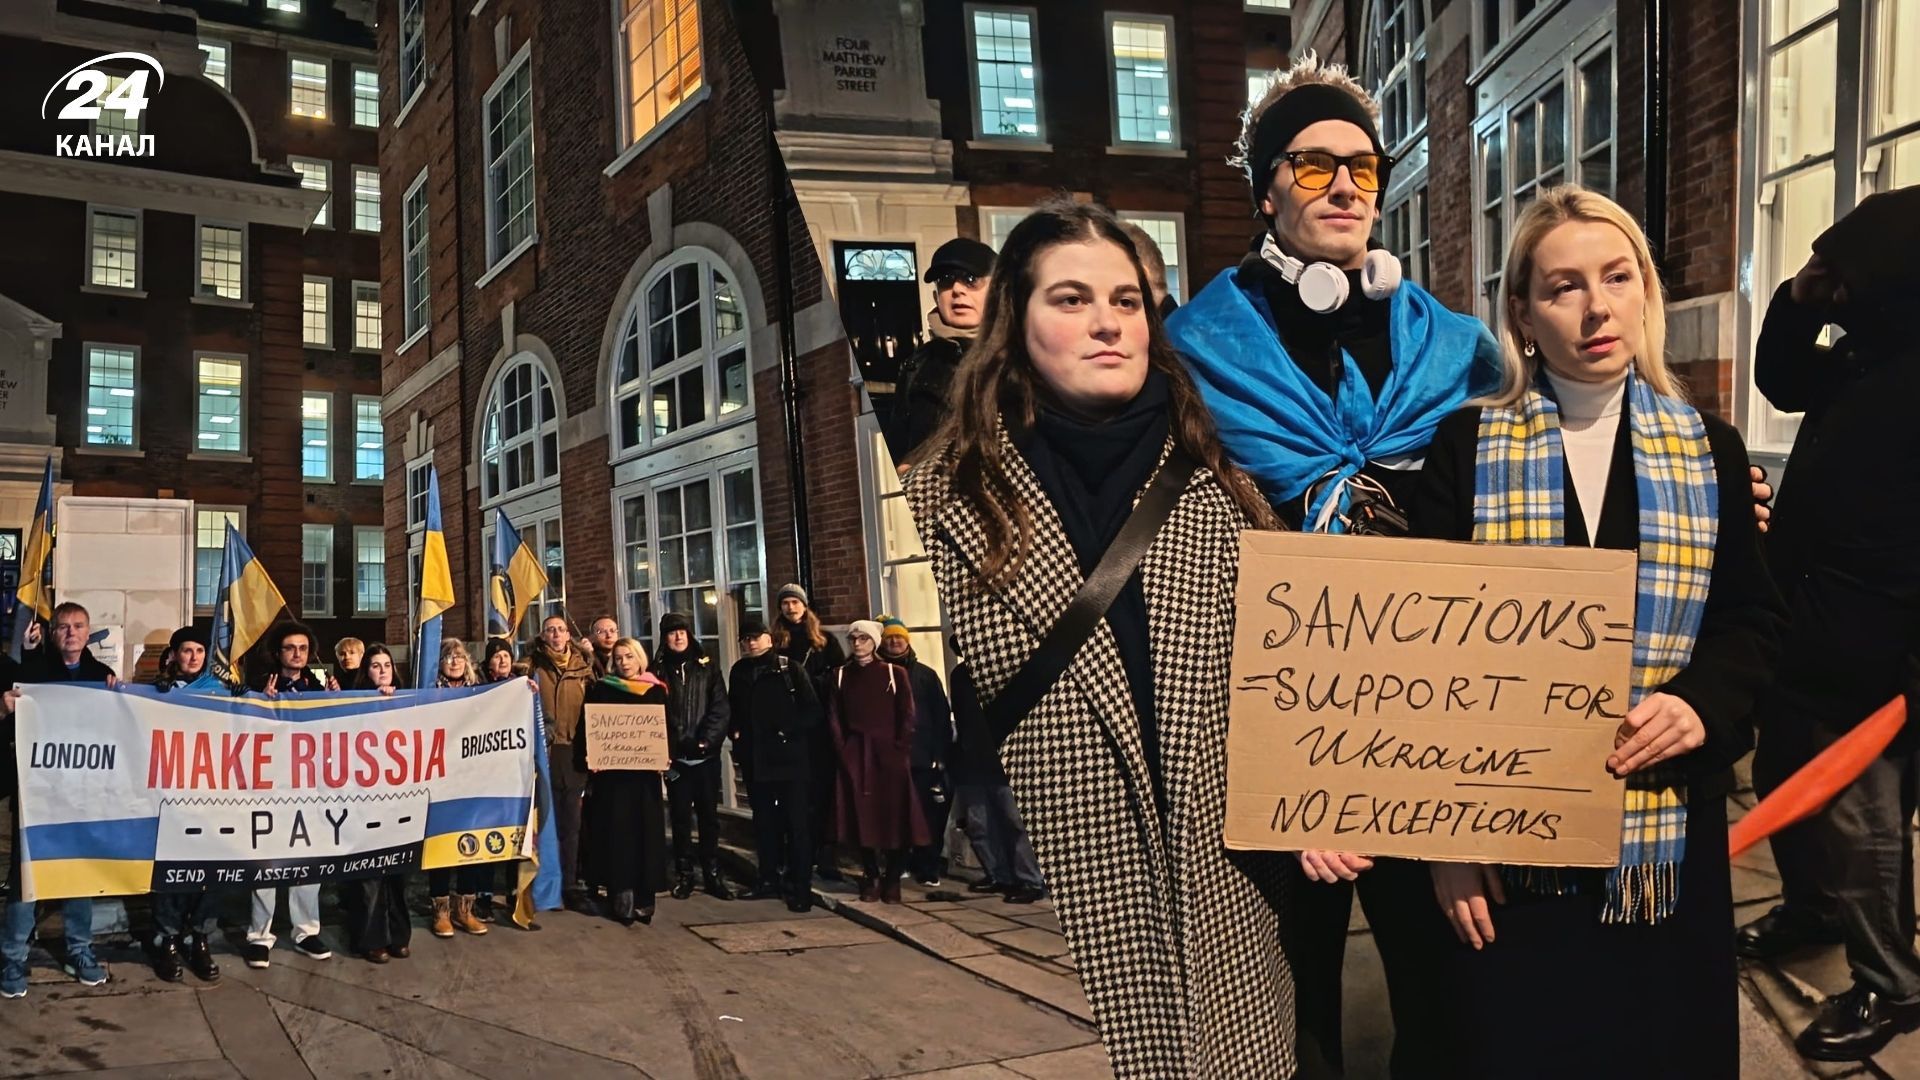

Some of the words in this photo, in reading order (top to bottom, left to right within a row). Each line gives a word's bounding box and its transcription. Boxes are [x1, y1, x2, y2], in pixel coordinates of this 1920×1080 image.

[822, 50, 886, 66] MATTHEW
[836, 37, 871, 51] FOUR
[834, 65, 878, 78] PARKER
[837, 79, 877, 92] STREET
[1544, 682, 1628, 719] FOR
[30, 742, 116, 770] LONDON
[461, 727, 527, 759] BRUSSELS
[147, 729, 275, 791] MAKE
[291, 728, 446, 790] RUSSIA
[1270, 789, 1331, 834] NO
[165, 869, 206, 883] SEND
[216, 869, 245, 883] THE
[253, 866, 310, 882] ASSETS
[319, 864, 336, 876] TO
[343, 850, 414, 873] UKRAINE!!
